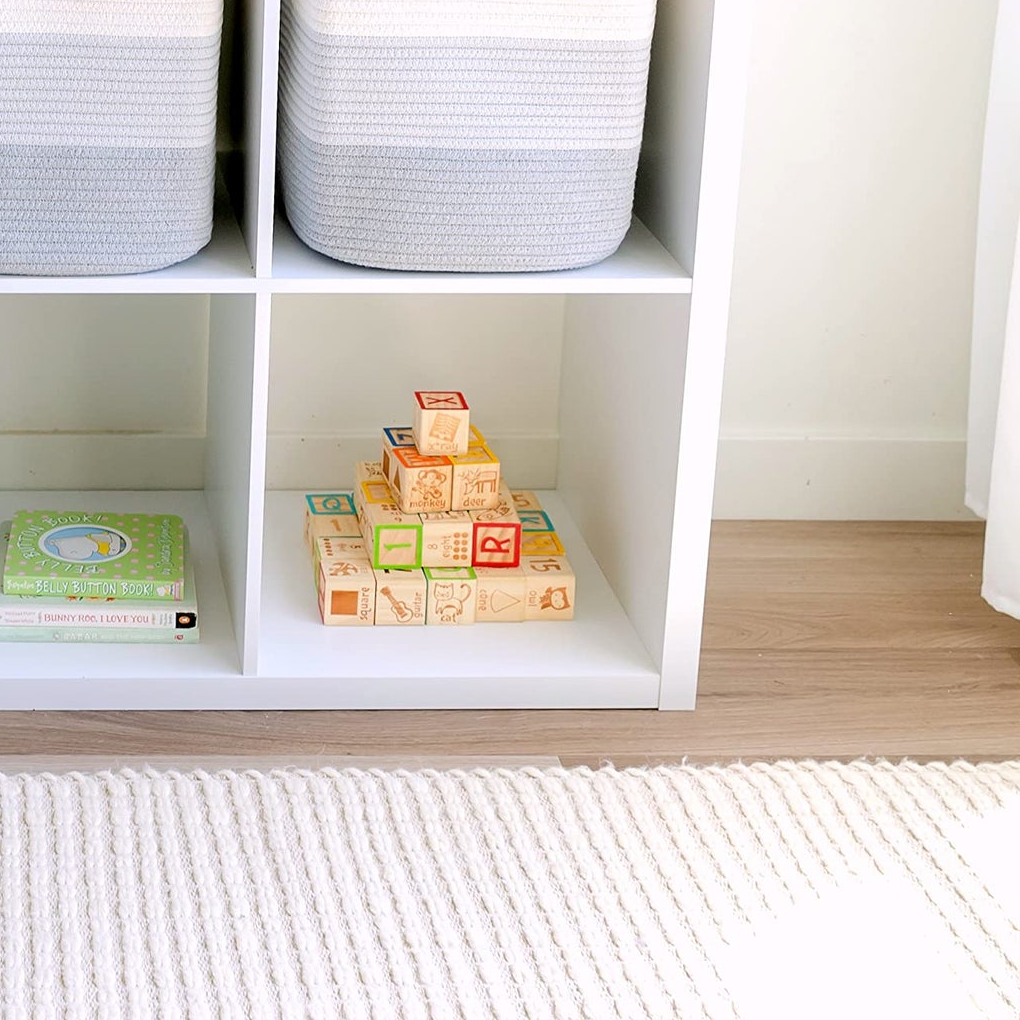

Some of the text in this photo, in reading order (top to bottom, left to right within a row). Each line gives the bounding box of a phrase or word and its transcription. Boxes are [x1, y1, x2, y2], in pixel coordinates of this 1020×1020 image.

[322, 496, 341, 510] Q
[410, 499, 446, 509] monkey
[463, 497, 486, 507] deer
[441, 535, 453, 558] eight
[480, 536, 511, 553] R
[529, 558, 562, 572] 15
[35, 580, 69, 594] BELLY
[72, 580, 117, 595] BUTTON
[120, 582, 154, 597] BOOK!
[360, 587, 372, 620] square
[414, 591, 423, 619] guitar
[479, 589, 488, 611] cone
[528, 590, 538, 607] owl
[44, 613, 76, 623] BUNNY
[106, 614, 129, 623] LOVE
[130, 615, 149, 623] YOU
[440, 612, 456, 623] cat
